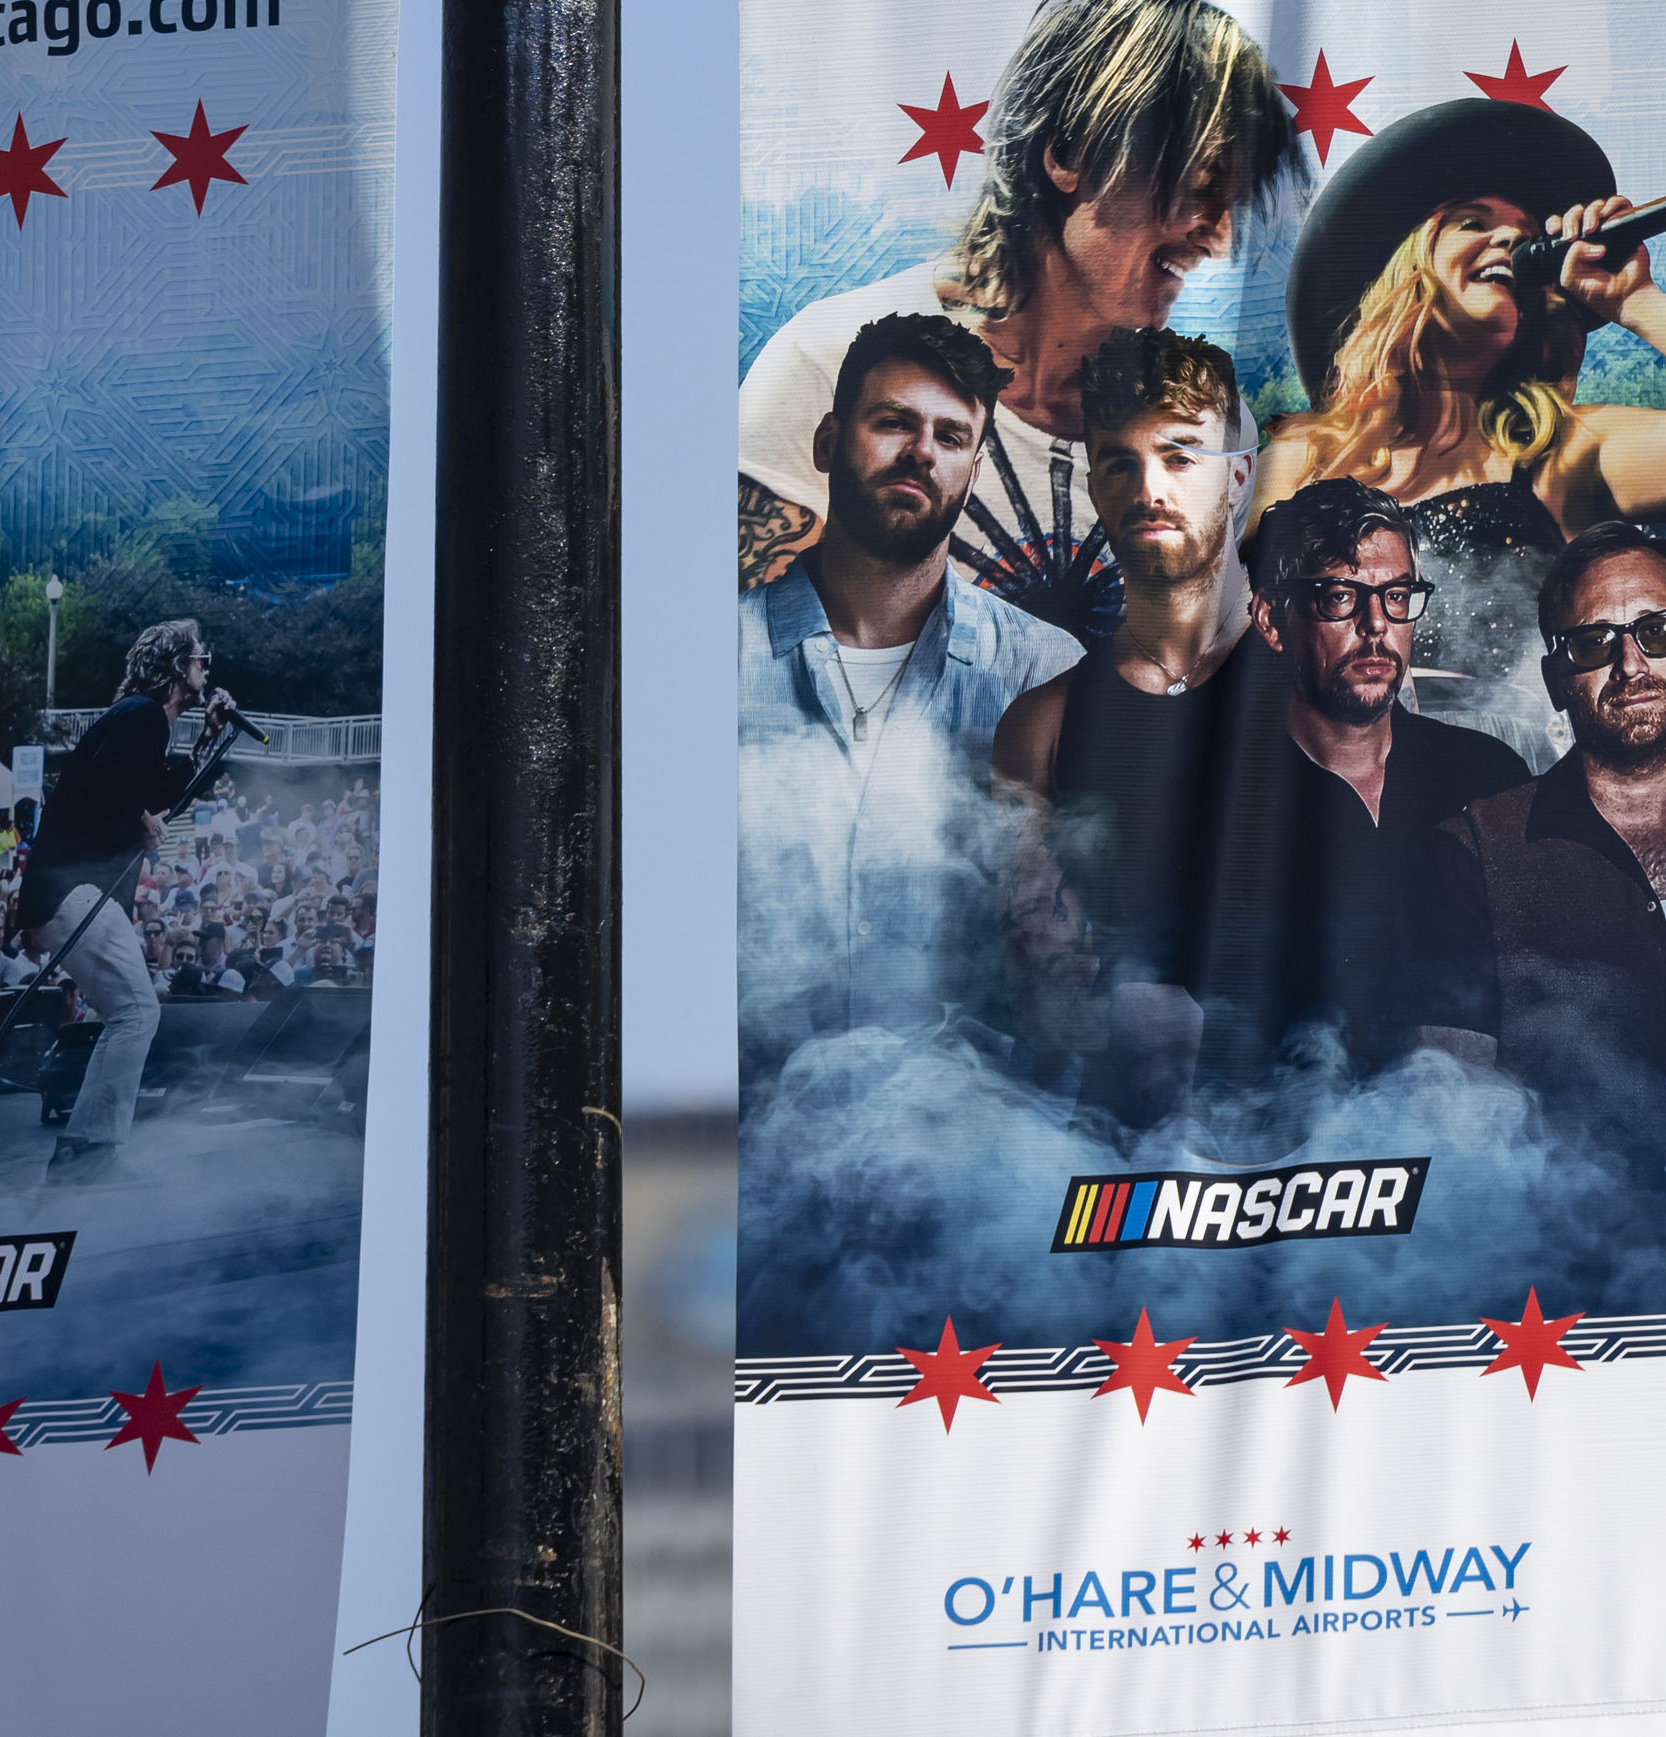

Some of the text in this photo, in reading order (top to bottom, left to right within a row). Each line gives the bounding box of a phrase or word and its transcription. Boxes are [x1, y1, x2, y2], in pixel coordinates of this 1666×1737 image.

[1147, 1166, 1410, 1242] NASCAR
[944, 1542, 1531, 1626] O'HARE & MIDWAY
[1037, 1605, 1437, 1653] INTERNATIONAL AIRPORTS
